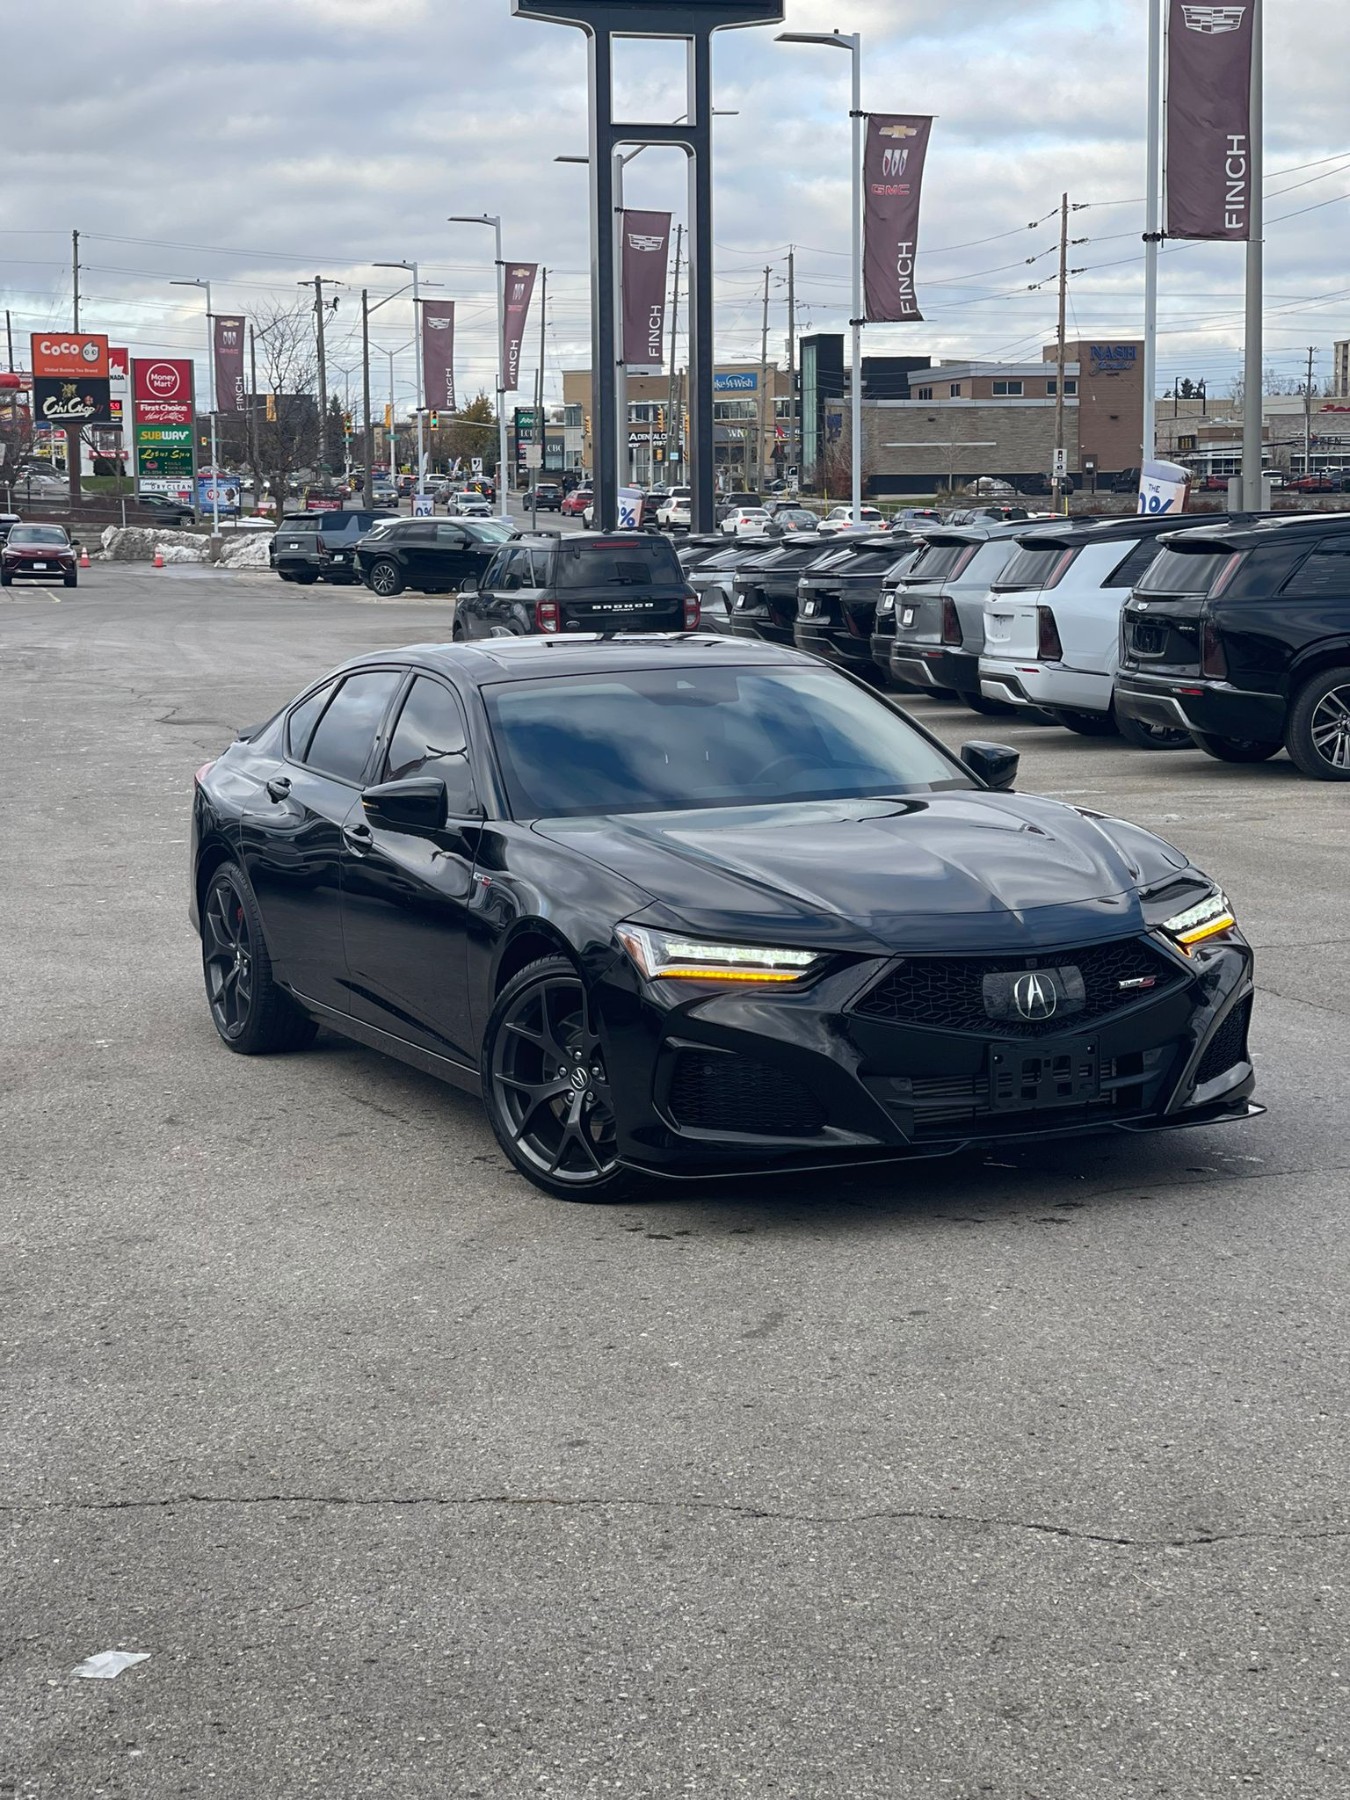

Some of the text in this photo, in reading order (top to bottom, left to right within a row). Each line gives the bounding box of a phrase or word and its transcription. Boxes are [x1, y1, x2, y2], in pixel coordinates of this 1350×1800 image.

[871, 183, 911, 196] GMC
[1225, 134, 1246, 229] FINCH
[897, 241, 917, 314] FINCH
[648, 305, 662, 357] FINCH
[1090, 345, 1137, 361] NASH
[151, 373, 175, 382] Money
[235, 376, 245, 411] FINCH
[445, 368, 454, 407] FINCH
[140, 431, 189, 440] SUBWAY
[1148, 483, 1160, 493] THE
[592, 602, 654, 610] BRONCO
